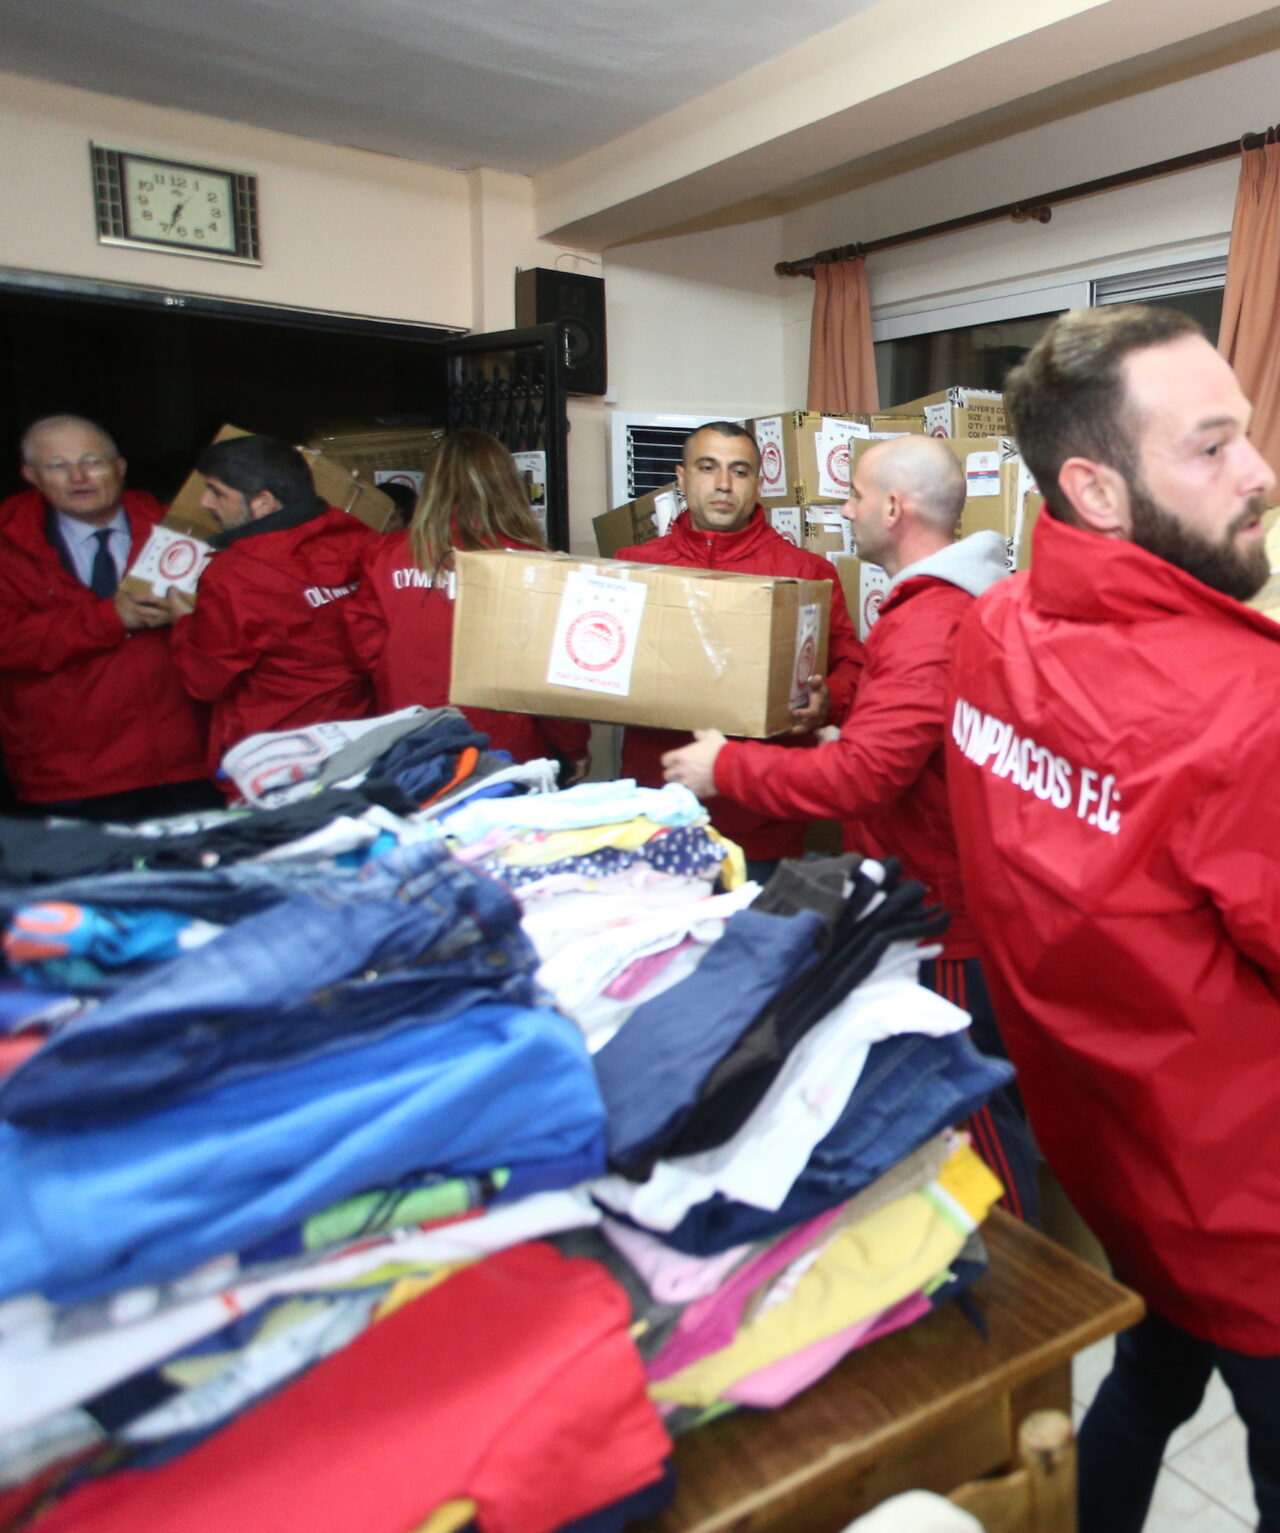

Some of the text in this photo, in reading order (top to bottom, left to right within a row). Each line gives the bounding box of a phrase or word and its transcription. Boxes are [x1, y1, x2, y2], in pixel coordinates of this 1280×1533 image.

[138, 180, 154, 192] 10
[170, 176, 187, 189] 12
[207, 192, 218, 204] 2
[211, 208, 221, 219] 3
[176, 226, 188, 238] 6
[207, 222, 218, 232] 4
